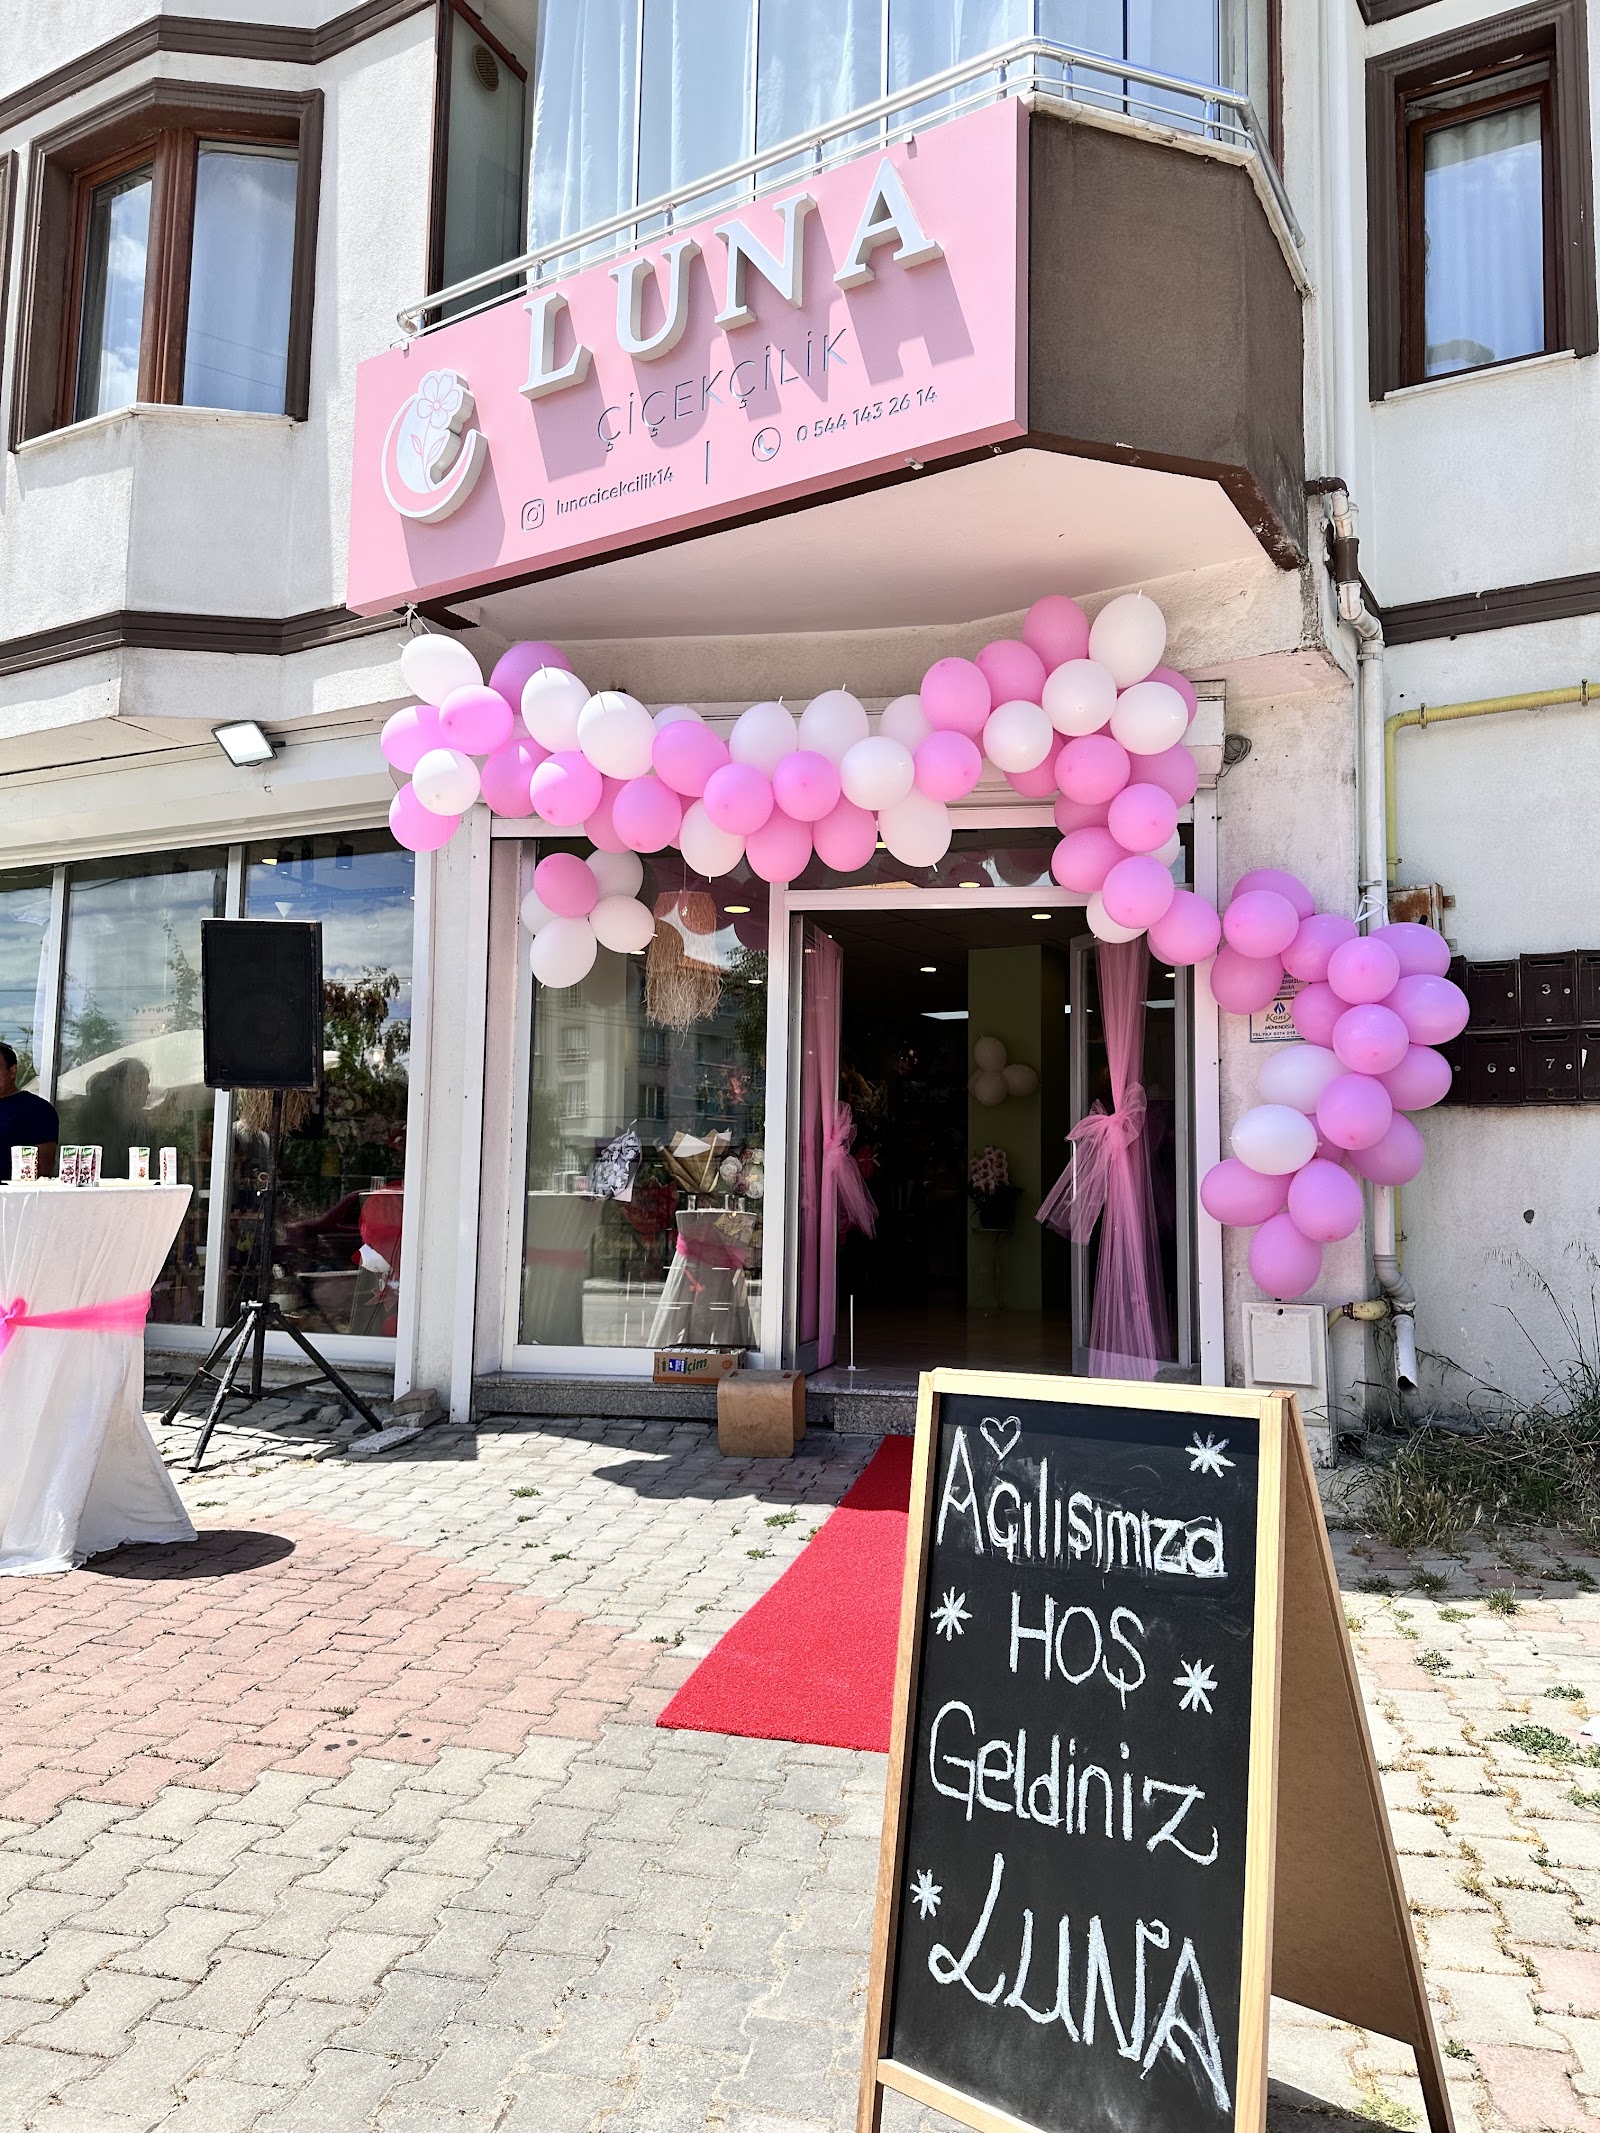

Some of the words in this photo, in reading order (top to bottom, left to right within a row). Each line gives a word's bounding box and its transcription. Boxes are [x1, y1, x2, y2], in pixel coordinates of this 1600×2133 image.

[519, 157, 944, 400] LUNA
[597, 328, 847, 452] ÇİÇEKÇİLİK
[796, 425, 809, 442] 0
[813, 413, 848, 438] 544
[853, 401, 884, 426] 143
[888, 394, 911, 416] 26
[916, 386, 938, 407] 14
[556, 466, 674, 516] lunacicekcilik14
[1541, 983, 1552, 995] 3
[1487, 1062, 1497, 1073] 6
[1545, 1058, 1555, 1069] 7
[1010, 1590, 1147, 1710] HOŞ
[929, 1700, 1219, 1866] Geldiniz
[927, 1852, 1232, 2113] LUNA
